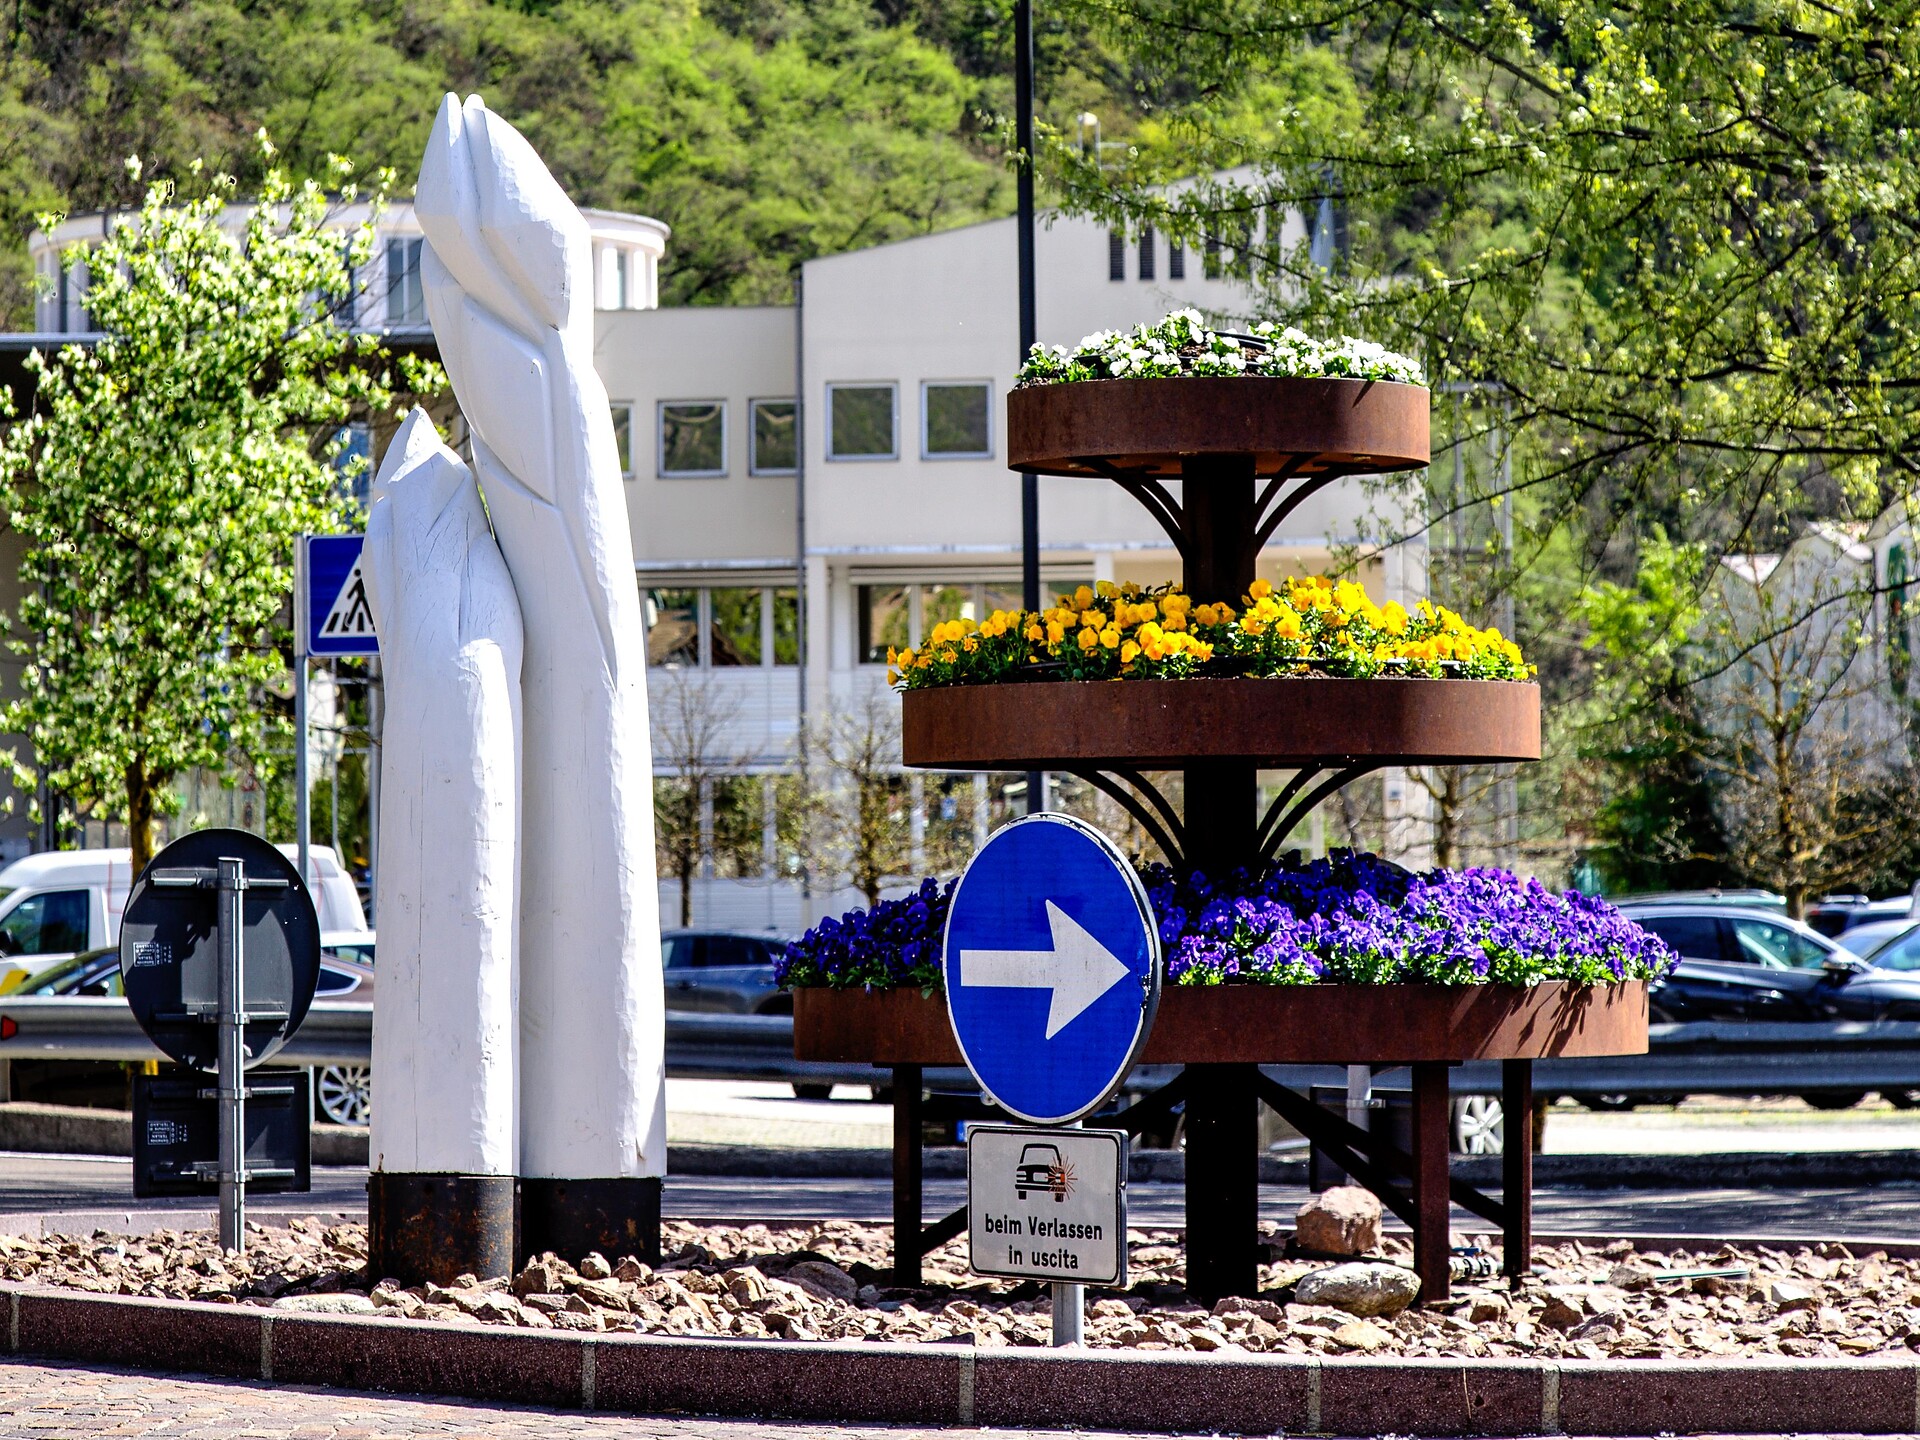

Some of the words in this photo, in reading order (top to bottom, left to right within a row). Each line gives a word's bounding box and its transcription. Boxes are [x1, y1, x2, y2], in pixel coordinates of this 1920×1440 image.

[985, 1213, 1022, 1235] beim
[1028, 1216, 1103, 1240] Verlassen
[1008, 1245, 1023, 1265] in
[1032, 1249, 1079, 1269] uscita
